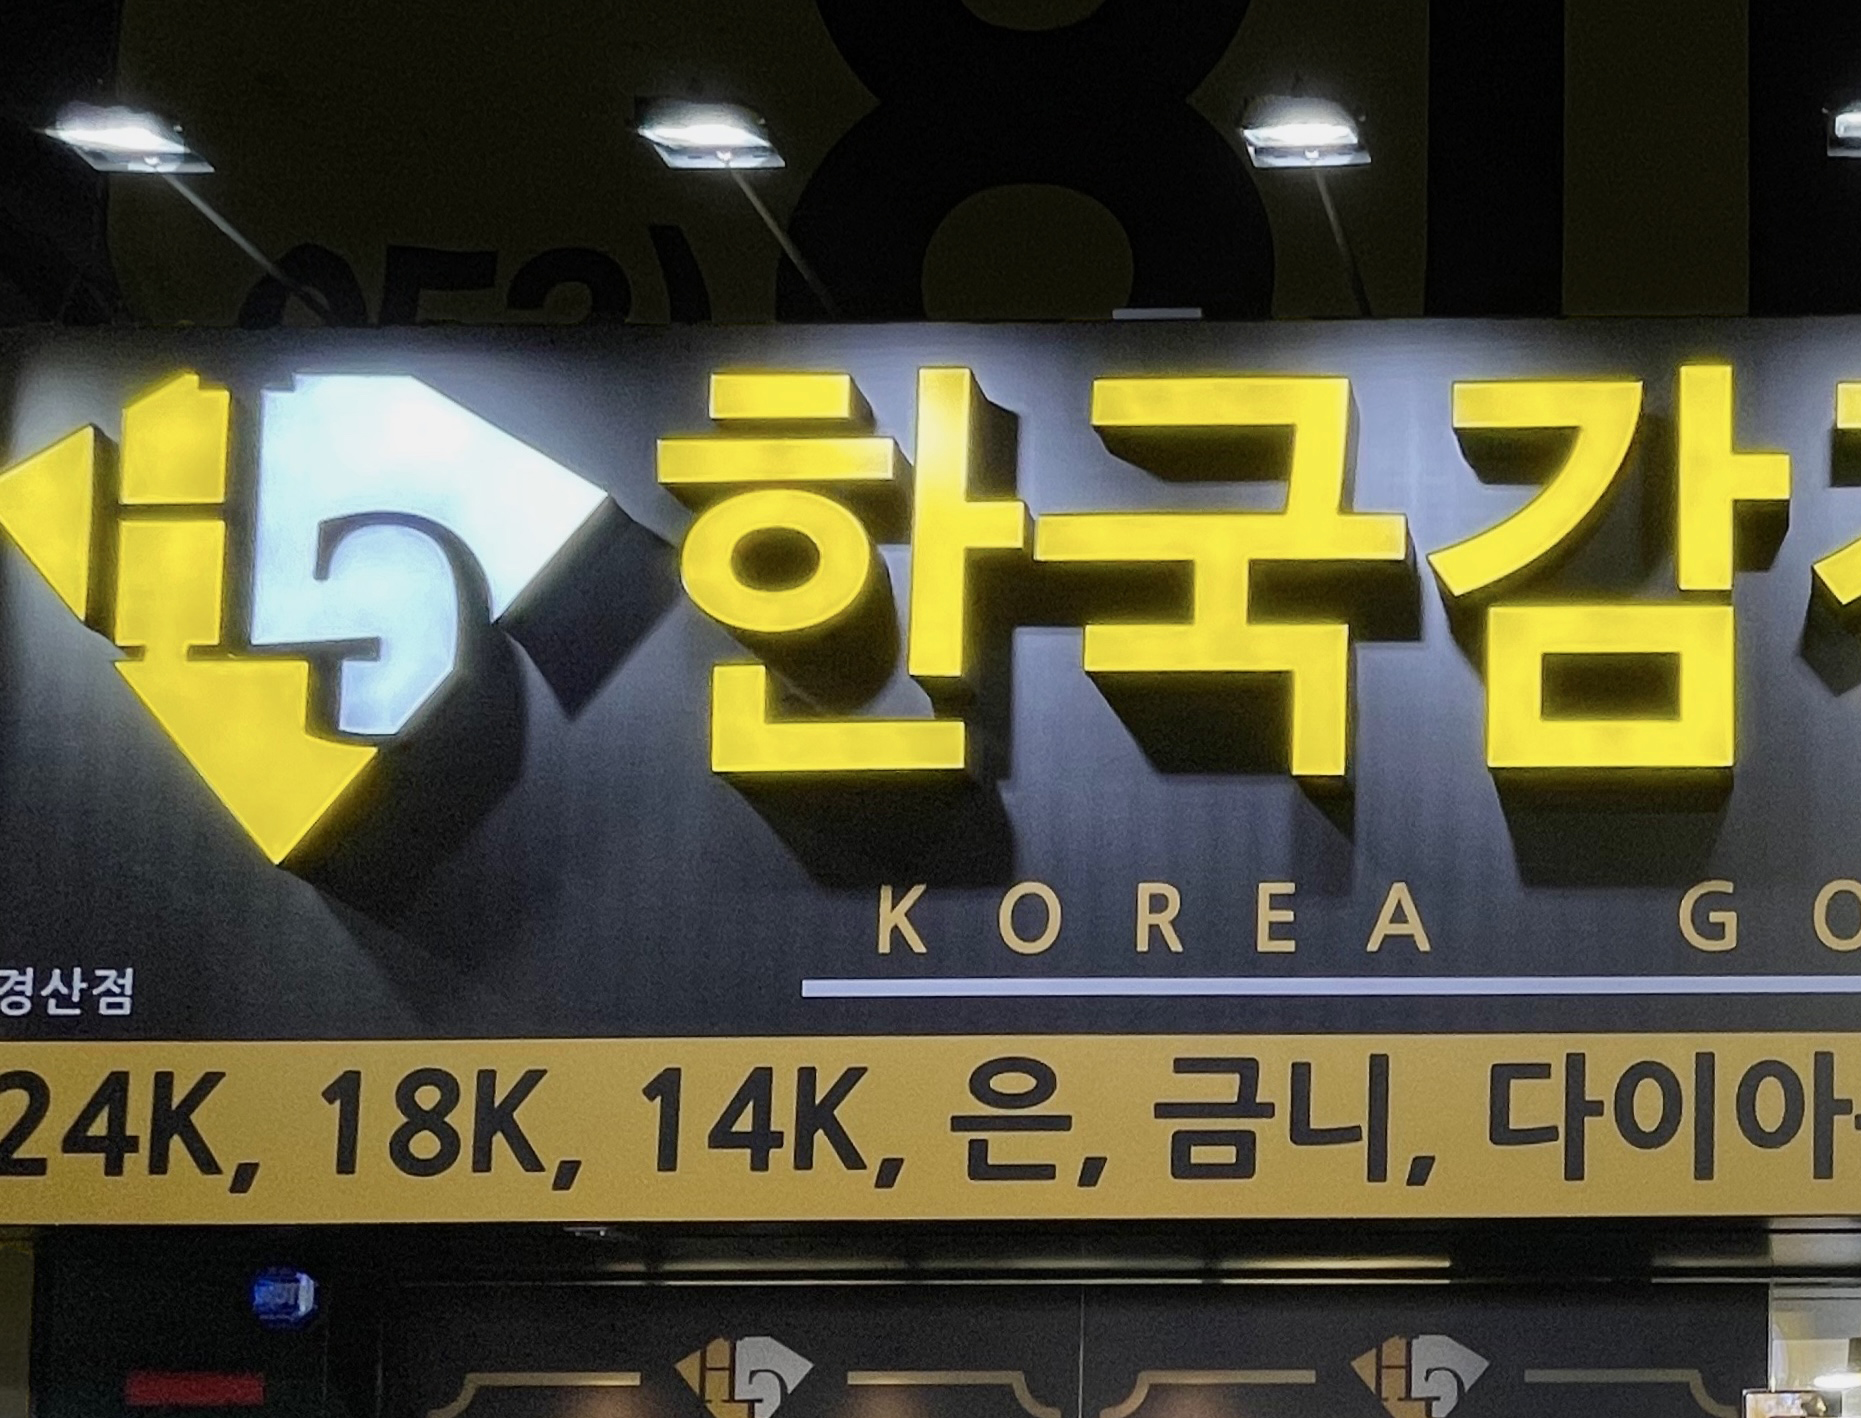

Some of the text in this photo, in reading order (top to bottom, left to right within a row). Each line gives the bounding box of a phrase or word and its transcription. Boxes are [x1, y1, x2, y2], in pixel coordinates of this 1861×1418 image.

[877, 880, 1431, 955] KOREA
[0, 967, 135, 1017] 경산점
[0, 1070, 260, 1194] 24K,
[321, 1066, 583, 1190] 18K,
[642, 1065, 906, 1189] 14K,
[950, 1056, 1108, 1187] 은,
[1154, 1053, 1436, 1187] 금니,
